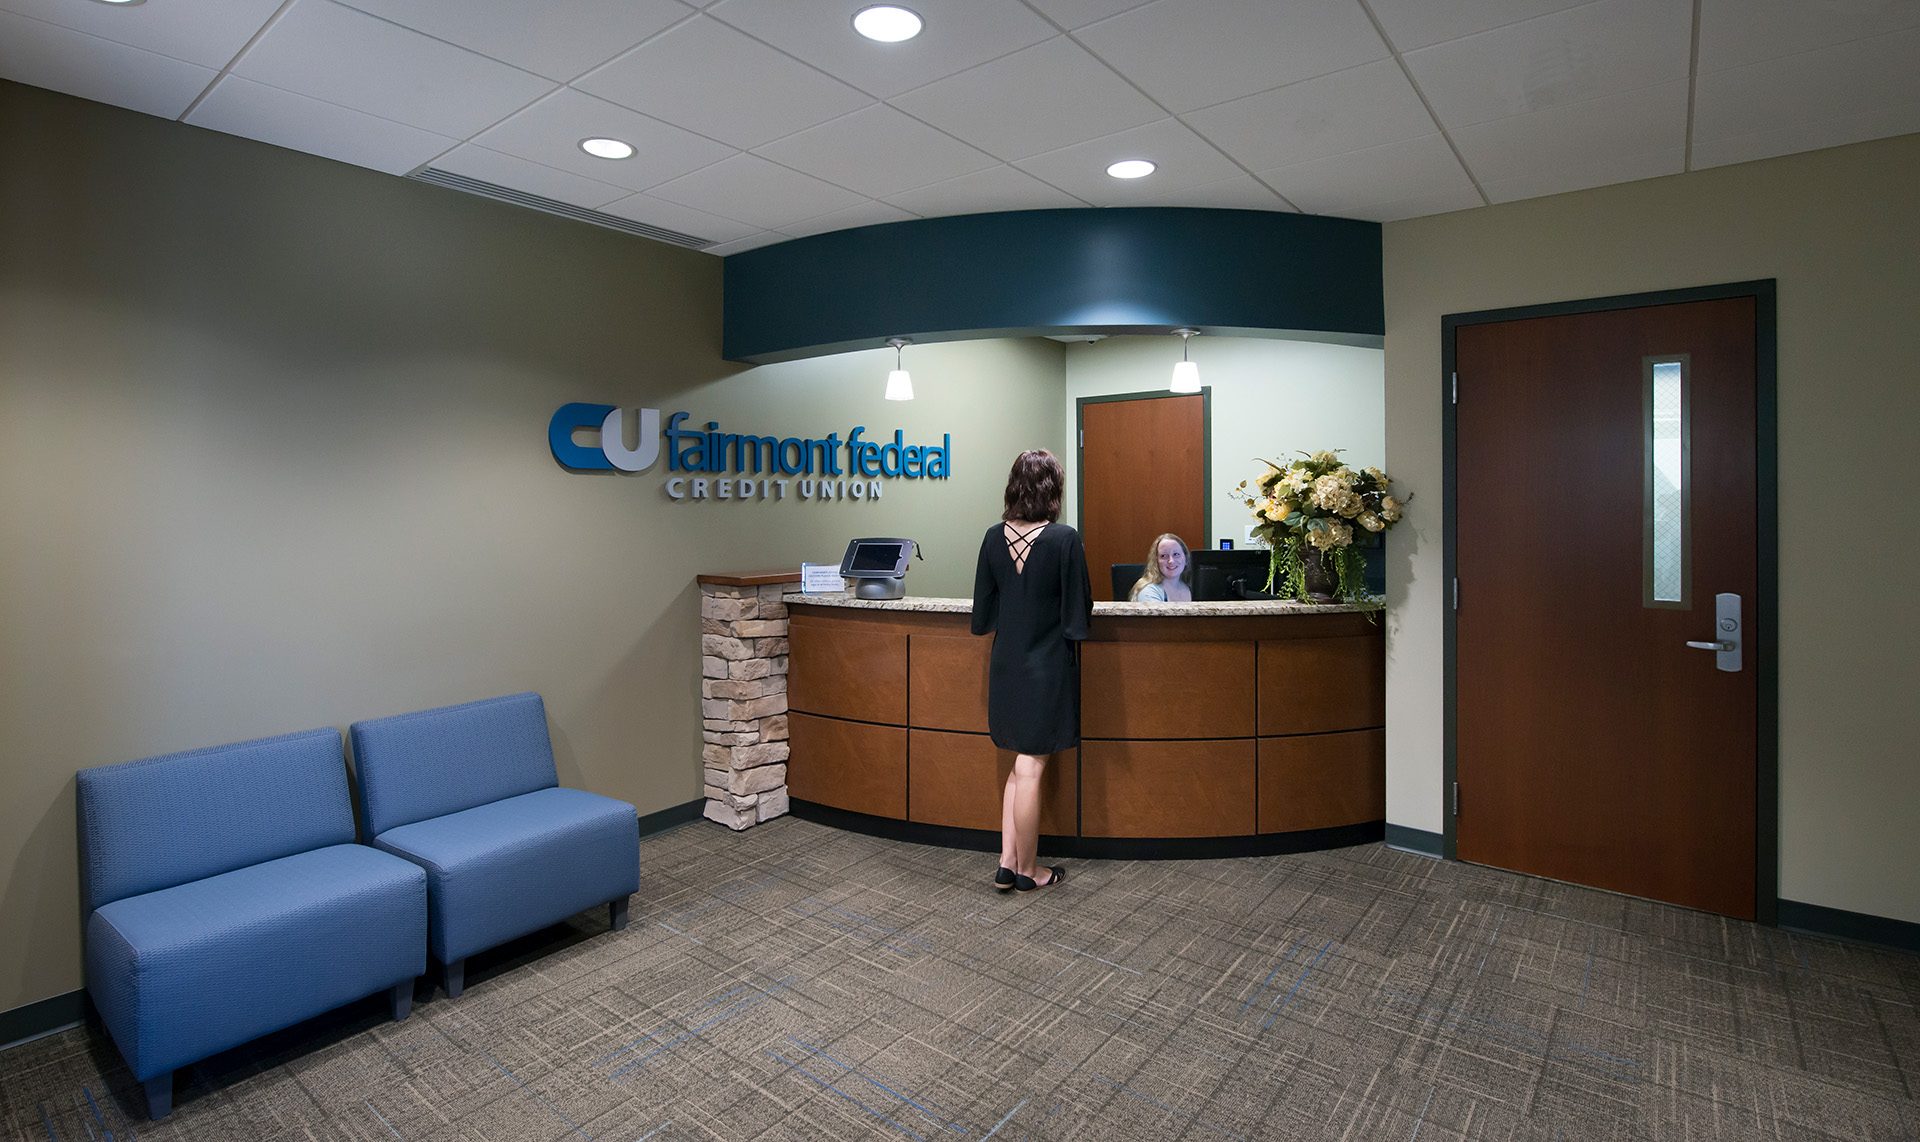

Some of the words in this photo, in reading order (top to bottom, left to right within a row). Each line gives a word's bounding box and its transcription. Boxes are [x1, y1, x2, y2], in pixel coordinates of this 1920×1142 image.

[548, 402, 660, 472] CU
[665, 411, 844, 475] fairmont
[847, 426, 951, 479] federal
[666, 478, 788, 499] CREDIT
[801, 480, 883, 500] UNION
